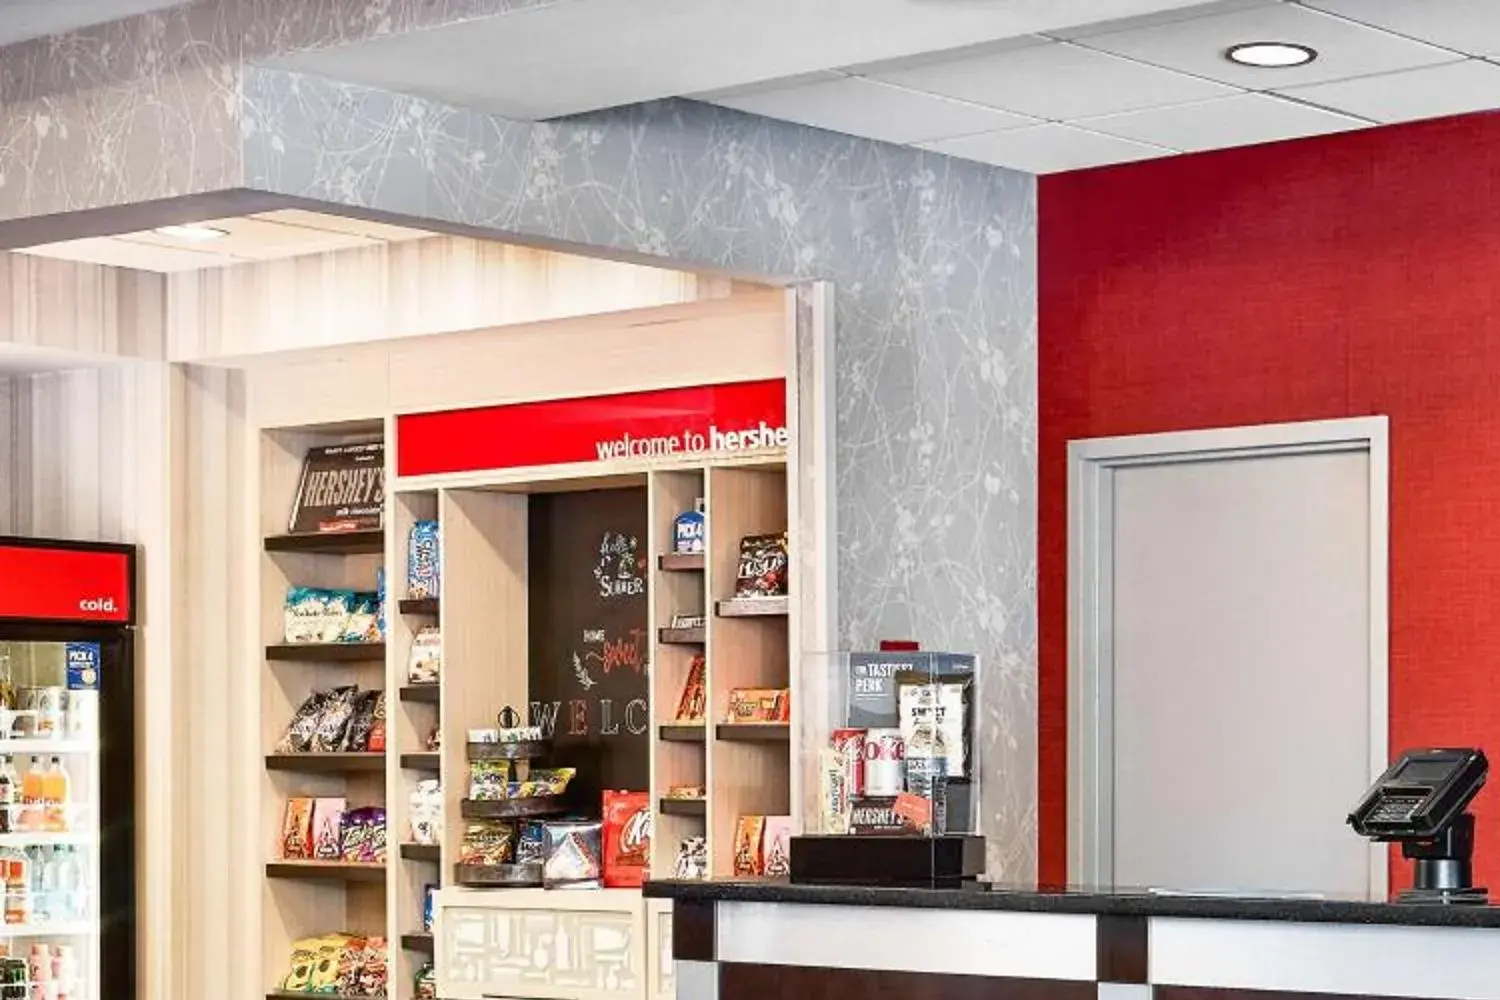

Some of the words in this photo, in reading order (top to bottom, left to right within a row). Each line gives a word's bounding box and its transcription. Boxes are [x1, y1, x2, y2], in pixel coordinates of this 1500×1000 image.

[596, 432, 680, 460] welcome
[684, 429, 704, 453] to
[79, 598, 119, 612] cold.
